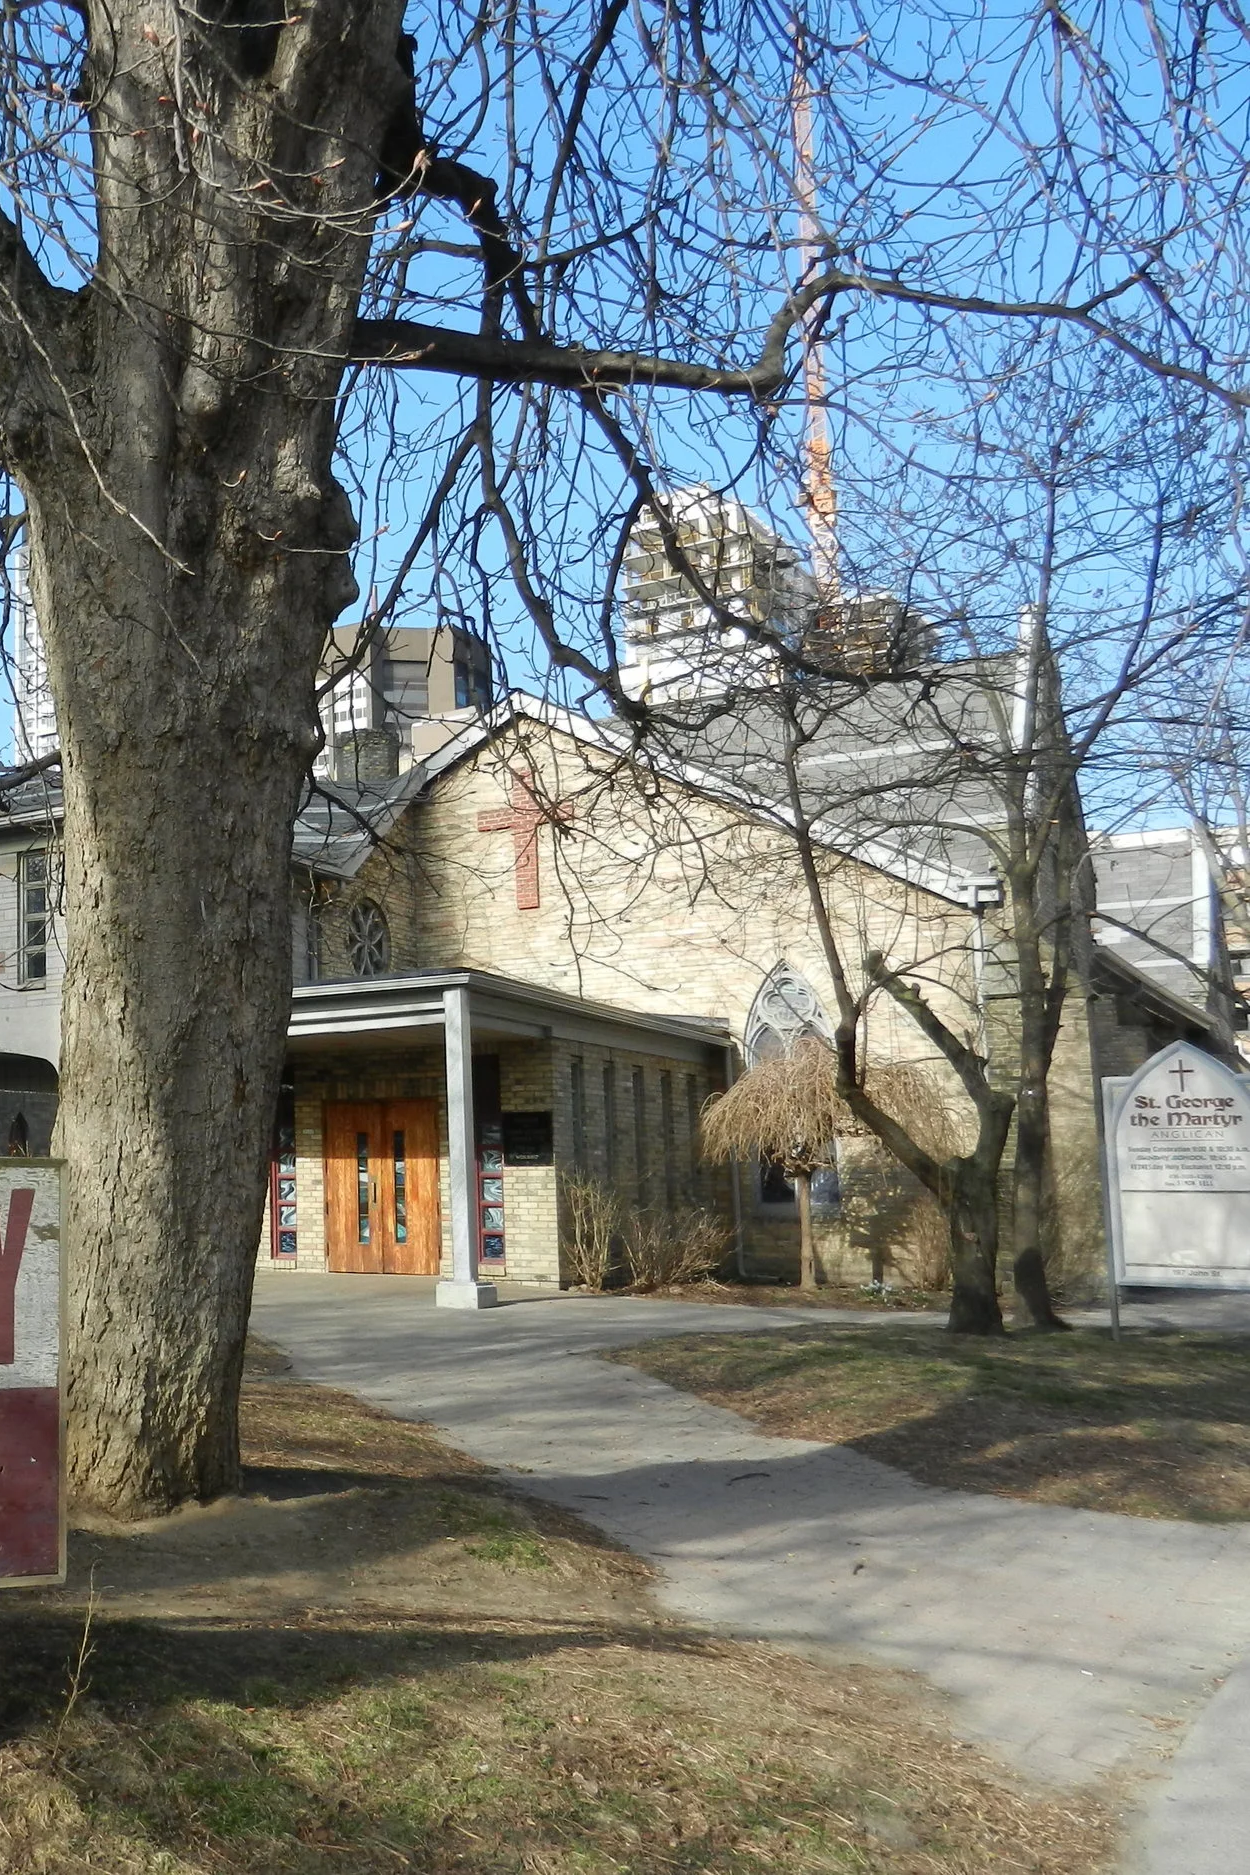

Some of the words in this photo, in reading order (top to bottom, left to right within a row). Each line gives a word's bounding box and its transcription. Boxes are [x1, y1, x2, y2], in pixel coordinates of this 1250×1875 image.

[1134, 1095, 1161, 1109] St.
[1165, 1095, 1235, 1112] George
[1130, 1111, 1160, 1127] the
[1167, 1112, 1243, 1128] Martyr
[1150, 1129, 1225, 1139] ANGLICAN
